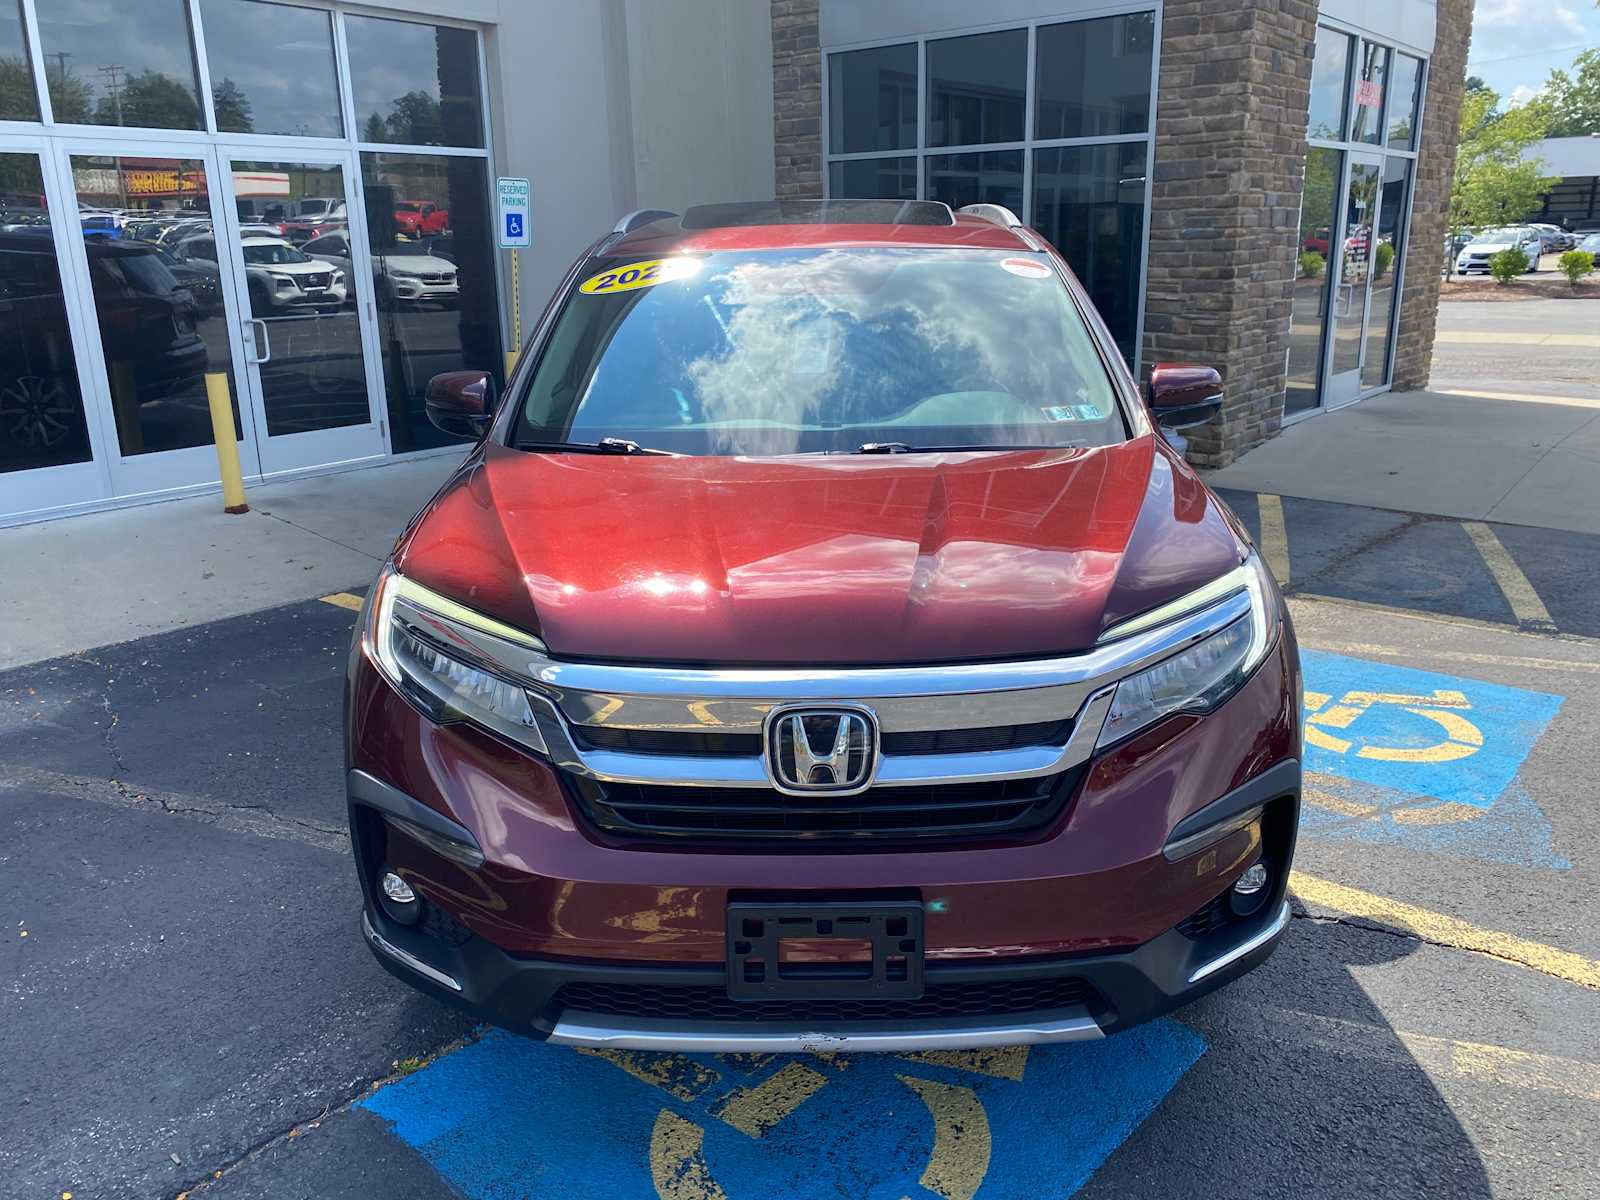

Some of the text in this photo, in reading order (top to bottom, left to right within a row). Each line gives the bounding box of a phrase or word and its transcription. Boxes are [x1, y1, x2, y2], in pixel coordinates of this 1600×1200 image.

[499, 185, 528, 194] RESERVED
[502, 197, 526, 207] PARKING
[593, 264, 664, 292] 202
